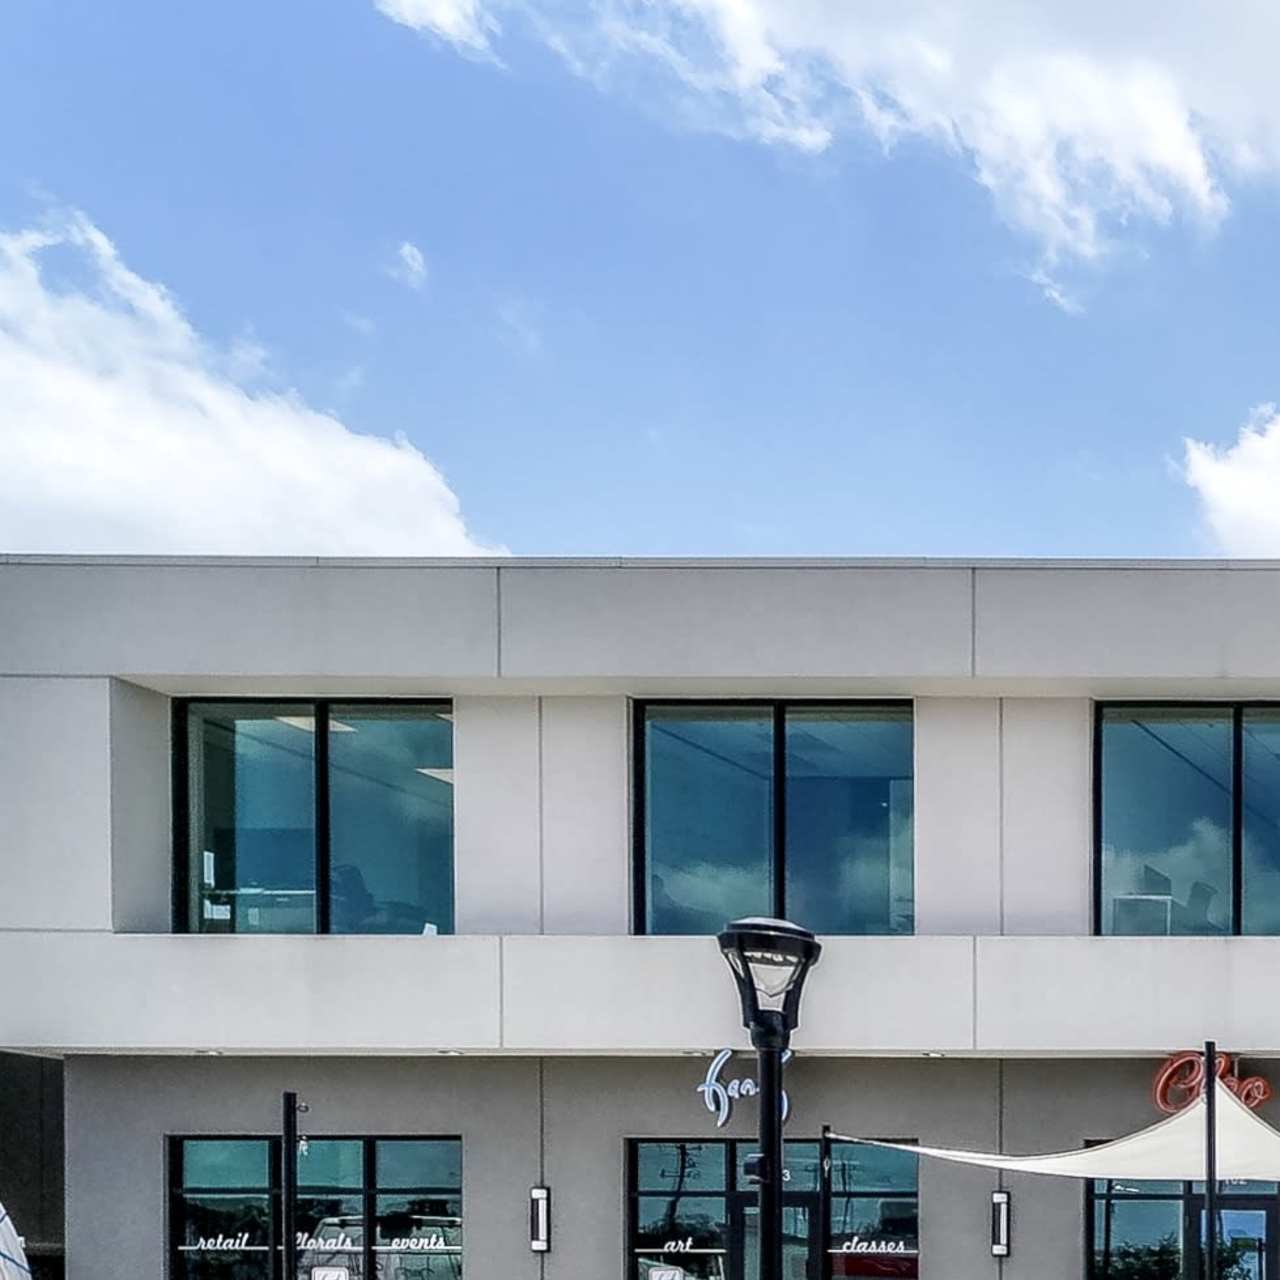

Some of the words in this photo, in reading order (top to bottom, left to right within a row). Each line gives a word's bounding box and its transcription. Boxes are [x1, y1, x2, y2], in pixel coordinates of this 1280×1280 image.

[197, 1232, 249, 1250] retail
[391, 1234, 445, 1250] events
[663, 1236, 693, 1253] art
[842, 1236, 905, 1253] classes
